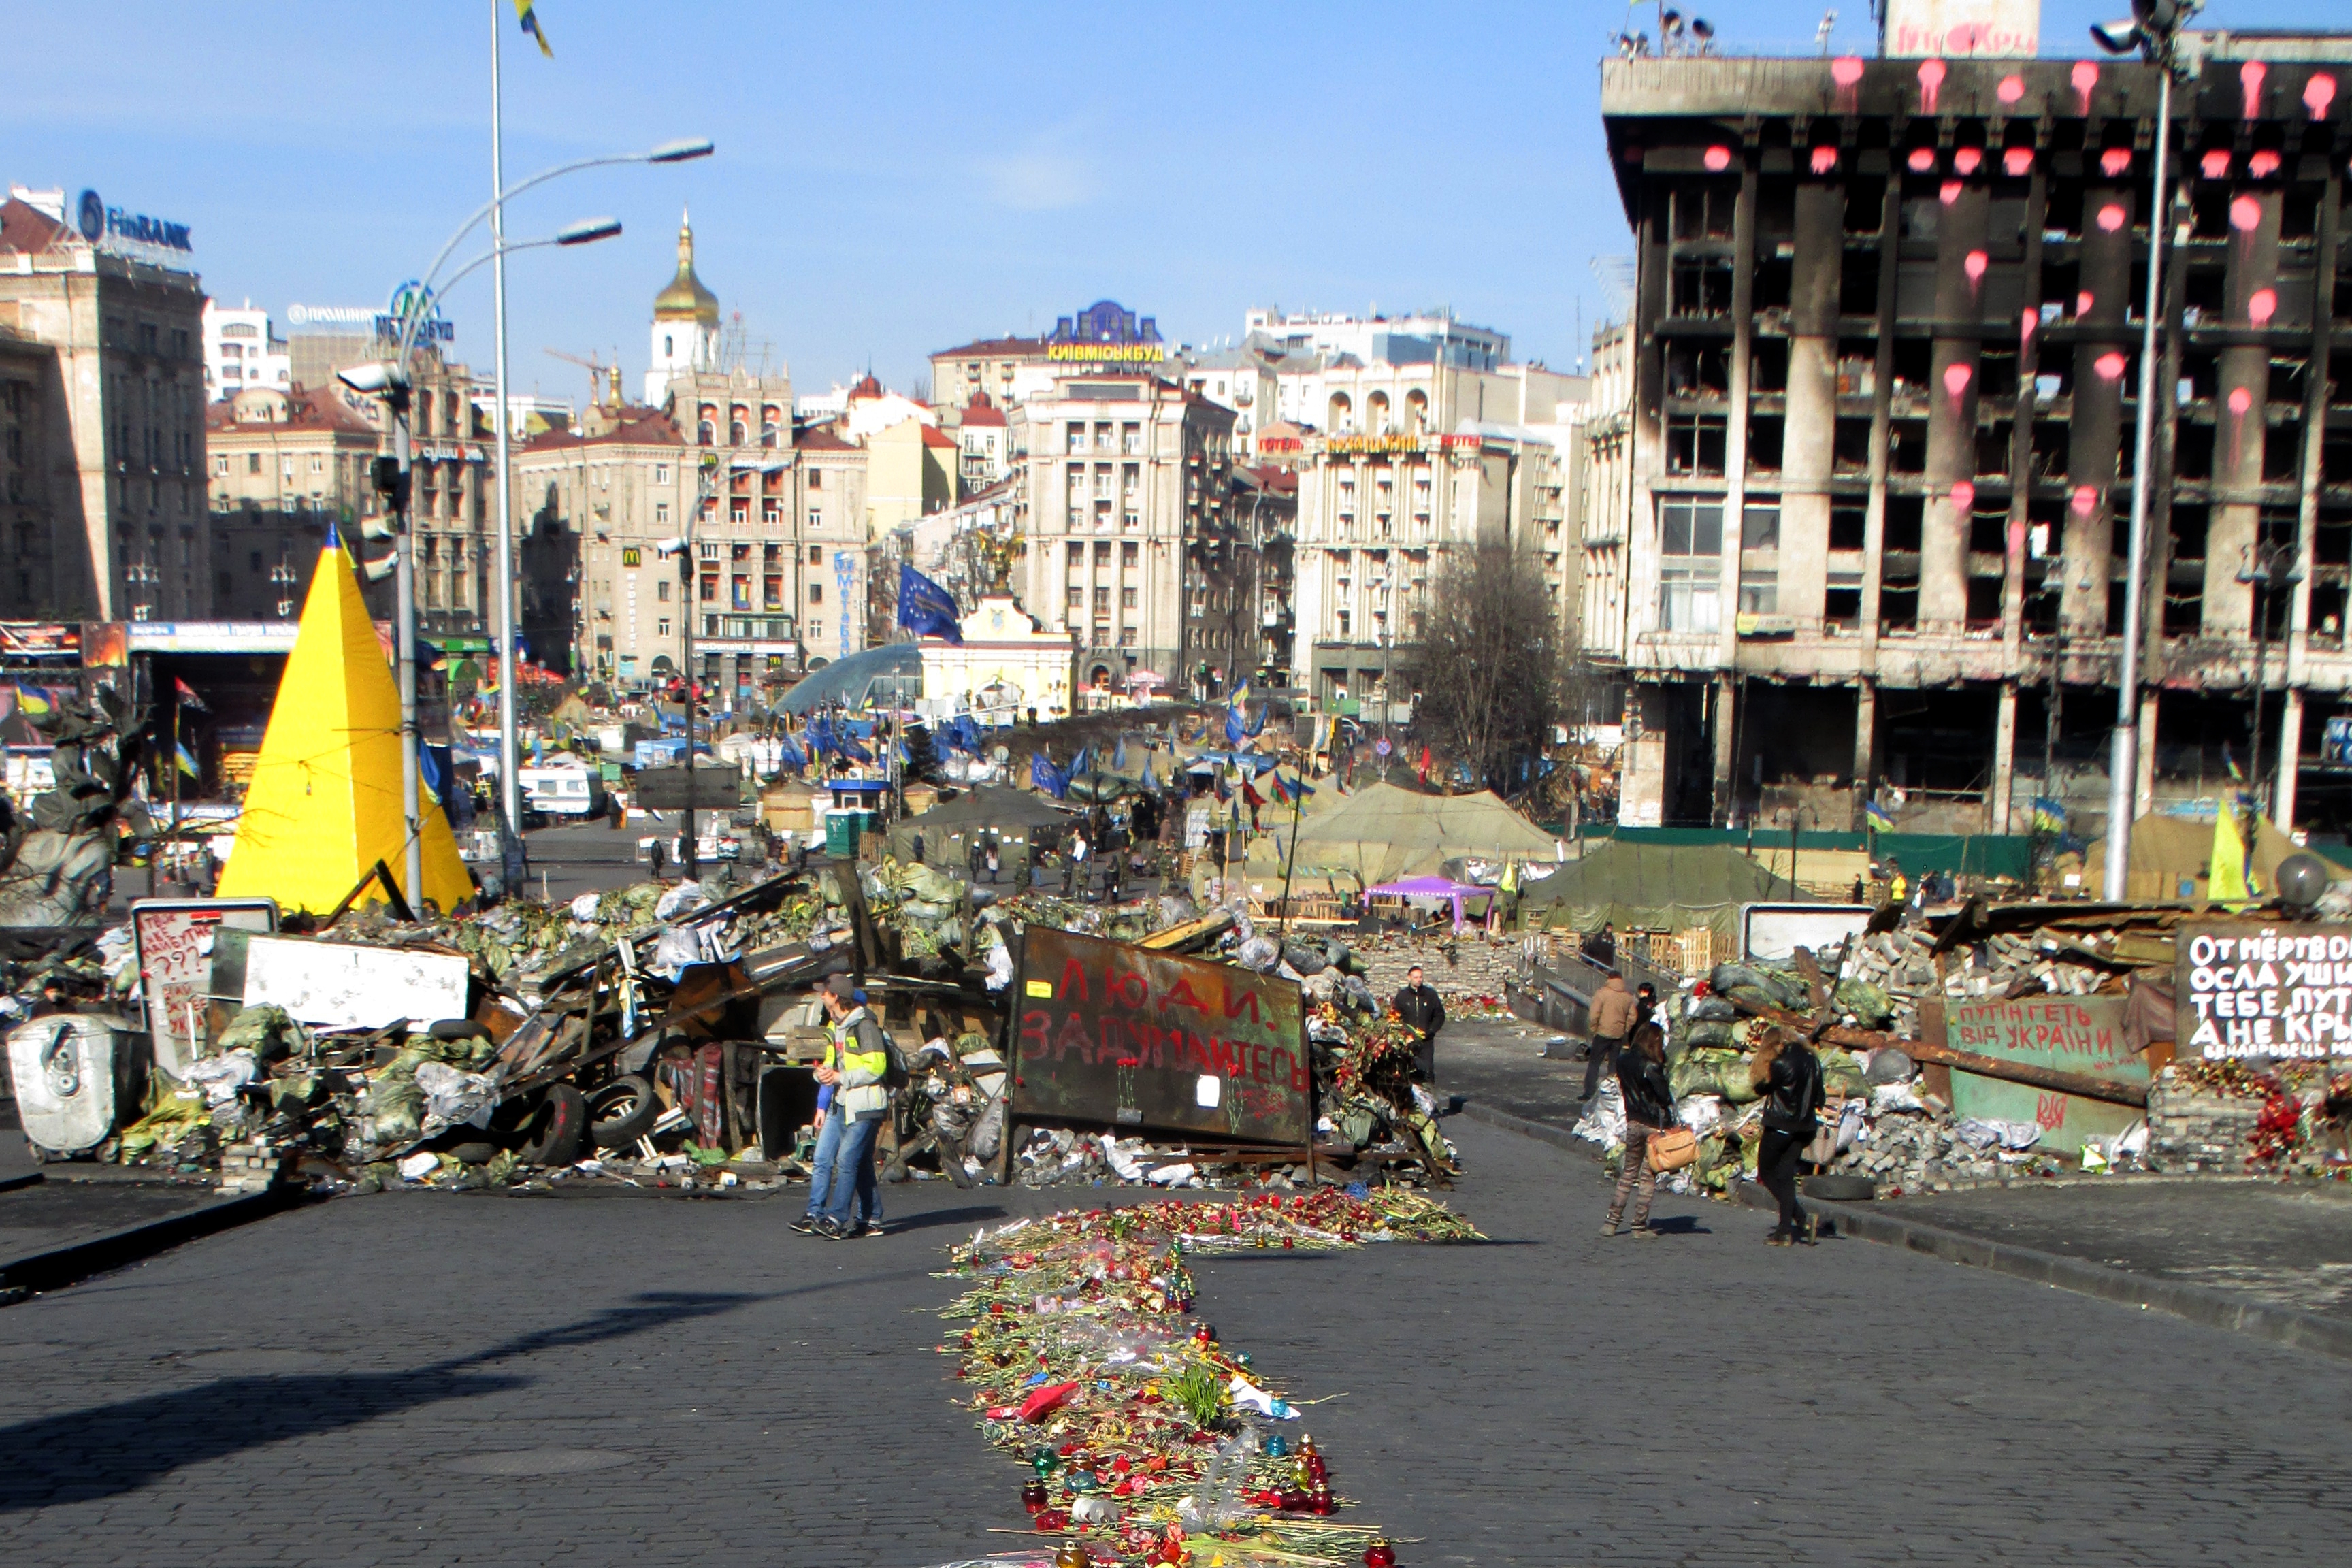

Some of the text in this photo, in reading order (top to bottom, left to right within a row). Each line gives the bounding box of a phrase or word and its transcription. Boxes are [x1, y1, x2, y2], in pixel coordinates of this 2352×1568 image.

[105, 206, 193, 252] FinBANK
[376, 316, 455, 340] МЕТОБУД
[1048, 343, 1164, 363] КИЇВМІСЬКБУД
[2239, 928, 2352, 962] МЁРТВО
[2189, 961, 2280, 992] ОСЛА
[1960, 1002, 2091, 1028] ПУТІН ГЕТЬ
[1961, 1023, 2114, 1057] ВІД УКРАЇНИ
[2189, 1019, 2221, 1046] А
[2226, 1019, 2274, 1045] НЕ
[1021, 1009, 1311, 1092] ЗАДУМАЙТЕСЬ
